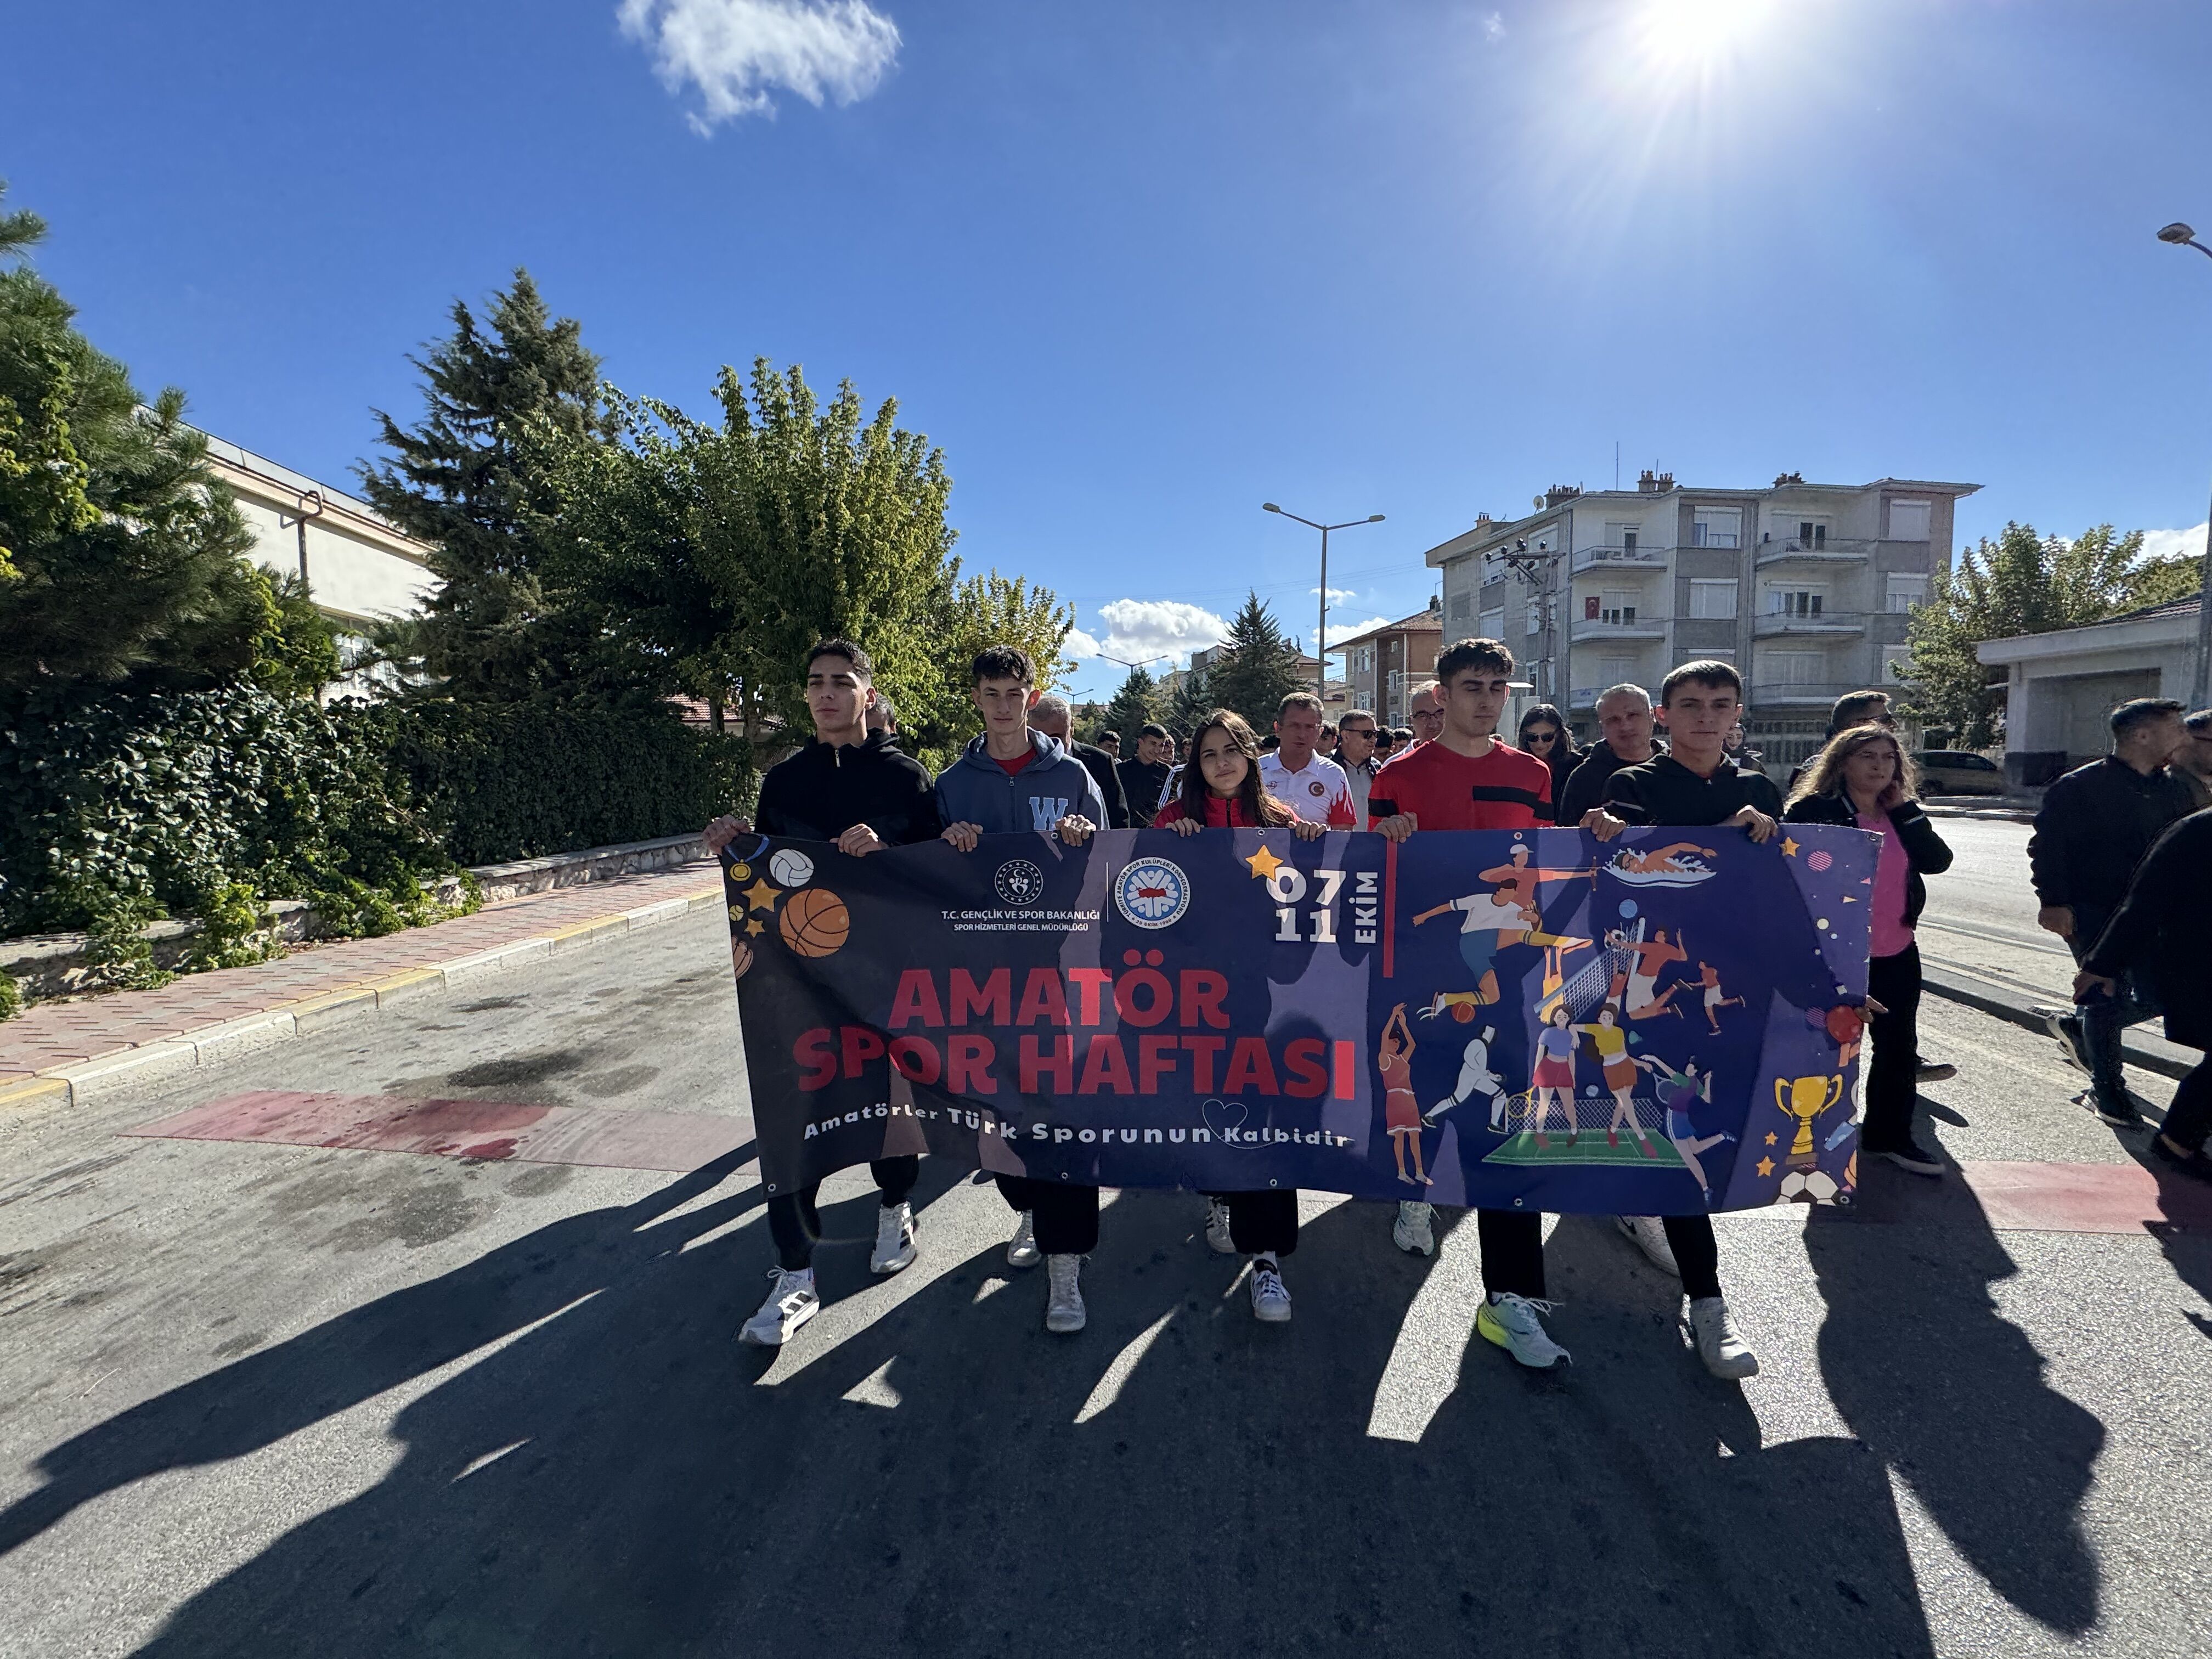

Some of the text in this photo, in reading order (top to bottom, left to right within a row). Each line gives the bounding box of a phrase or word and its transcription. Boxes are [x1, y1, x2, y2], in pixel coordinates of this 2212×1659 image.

[1116, 871, 1128, 894] AMATÖR
[1126, 862, 1141, 873] SPOR
[1141, 858, 1173, 869] KULÜPLERİ
[1266, 866, 1346, 906] 07
[941, 909, 1100, 921] T.C. GENÇLİK VE SPOR BAKANLIĞI
[974, 922, 1017, 931] HİZMETLERİ
[1041, 923, 1088, 932] MÜDÜRLÜĞÜ
[1276, 907, 1336, 943] 11
[1348, 872, 1378, 944] EKİM
[888, 949, 1231, 1028] AMATÖR
[792, 1025, 1355, 1100] SPOR HAFTASI
[803, 1103, 1347, 1147] Amatörler Türk Sporunun Kalbidir
